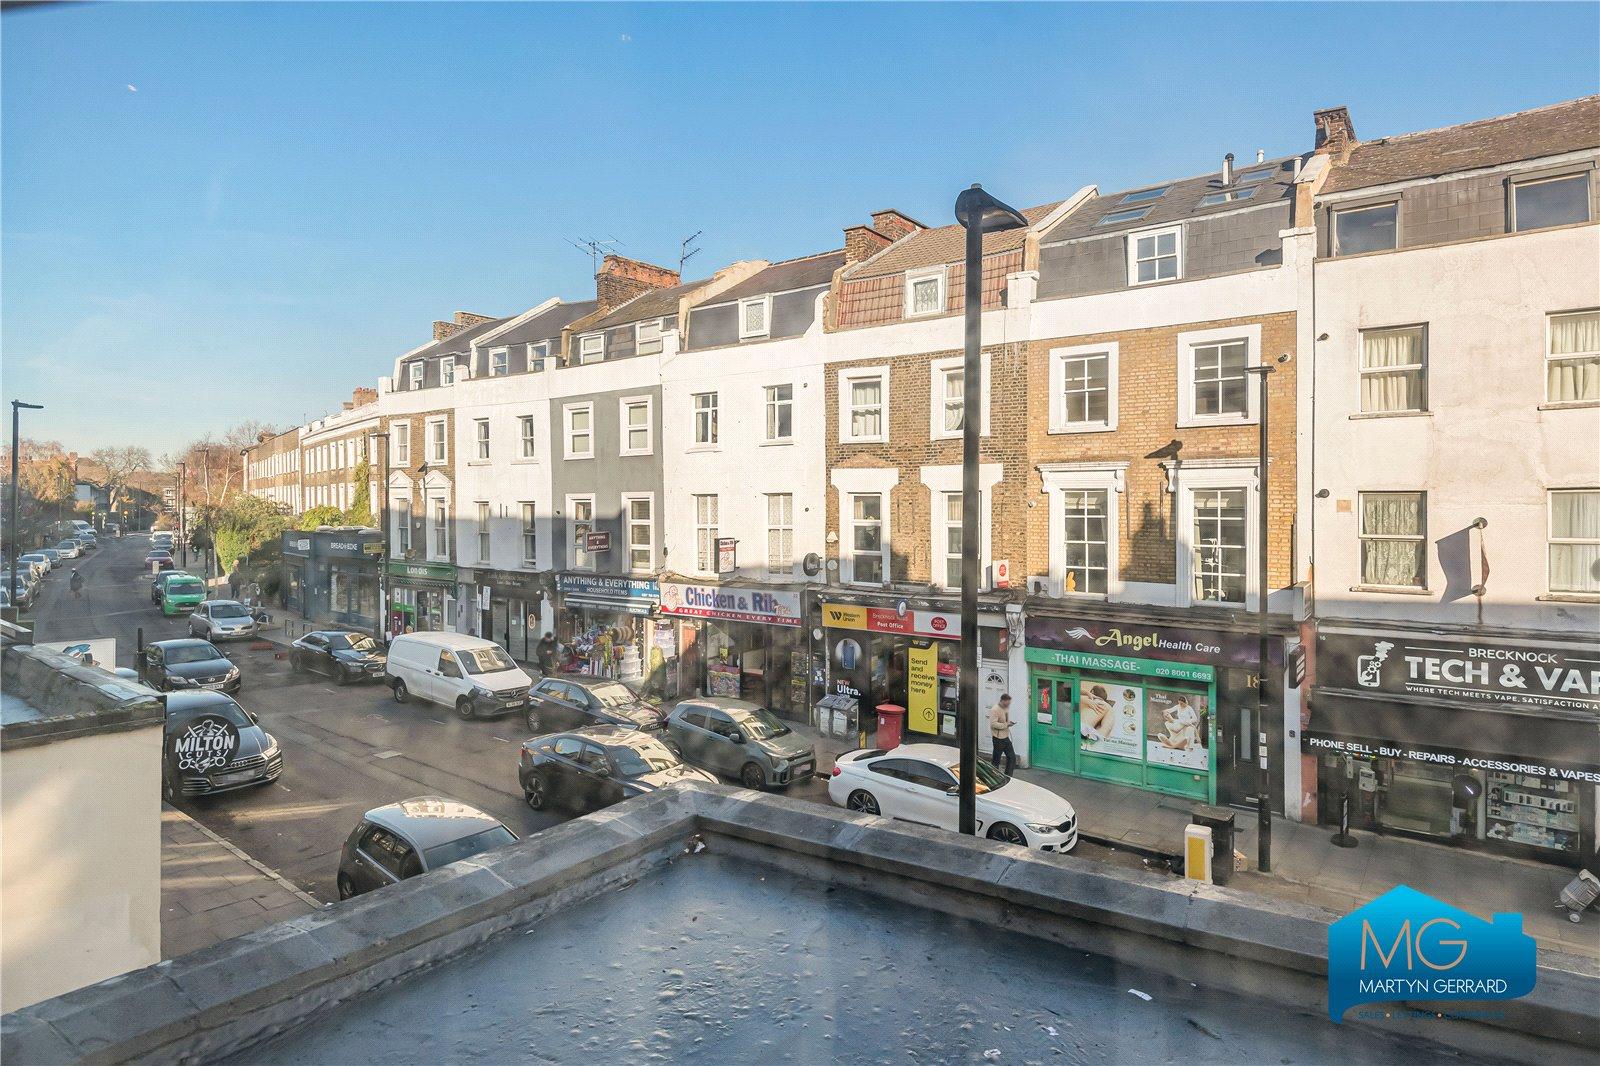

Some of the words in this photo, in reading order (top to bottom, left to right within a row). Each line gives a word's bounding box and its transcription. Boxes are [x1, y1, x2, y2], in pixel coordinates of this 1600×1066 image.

[563, 576, 597, 586] ANYTHING
[605, 579, 650, 590] EVERYTHING
[685, 586, 736, 609] Chicken
[737, 597, 749, 611] &
[678, 607, 702, 615] GREAT
[706, 610, 742, 618] CHICKEN
[1095, 628, 1158, 651] Angel
[1158, 639, 1192, 650] Health
[1195, 643, 1221, 654] Care
[911, 657, 928, 665] Send
[1468, 648, 1558, 664] BRECKNOCK
[1155, 668, 1169, 676] 020
[1171, 669, 1190, 677] 8001
[1192, 671, 1212, 680] 6693
[1404, 656, 1489, 685] TECH
[1499, 663, 1528, 689] &
[837, 685, 861, 696] Ultra.
[911, 681, 933, 689] money
[1405, 686, 1435, 694] WHERE
[1462, 691, 1492, 700] MEETS
[1522, 697, 1590, 709] SATISFACTION
[175, 735, 235, 753] MILTON
[186, 750, 221, 758] CUTS
[1309, 738, 1345, 750] PHONE
[1346, 742, 1372, 753] SELL
[1380, 747, 1402, 757] BUY
[1408, 751, 1456, 764] REPAIRS
[1463, 758, 1547, 775] ACCESSORIES
[1549, 768, 1558, 777] &
[1560, 769, 1600, 783] VAPES
